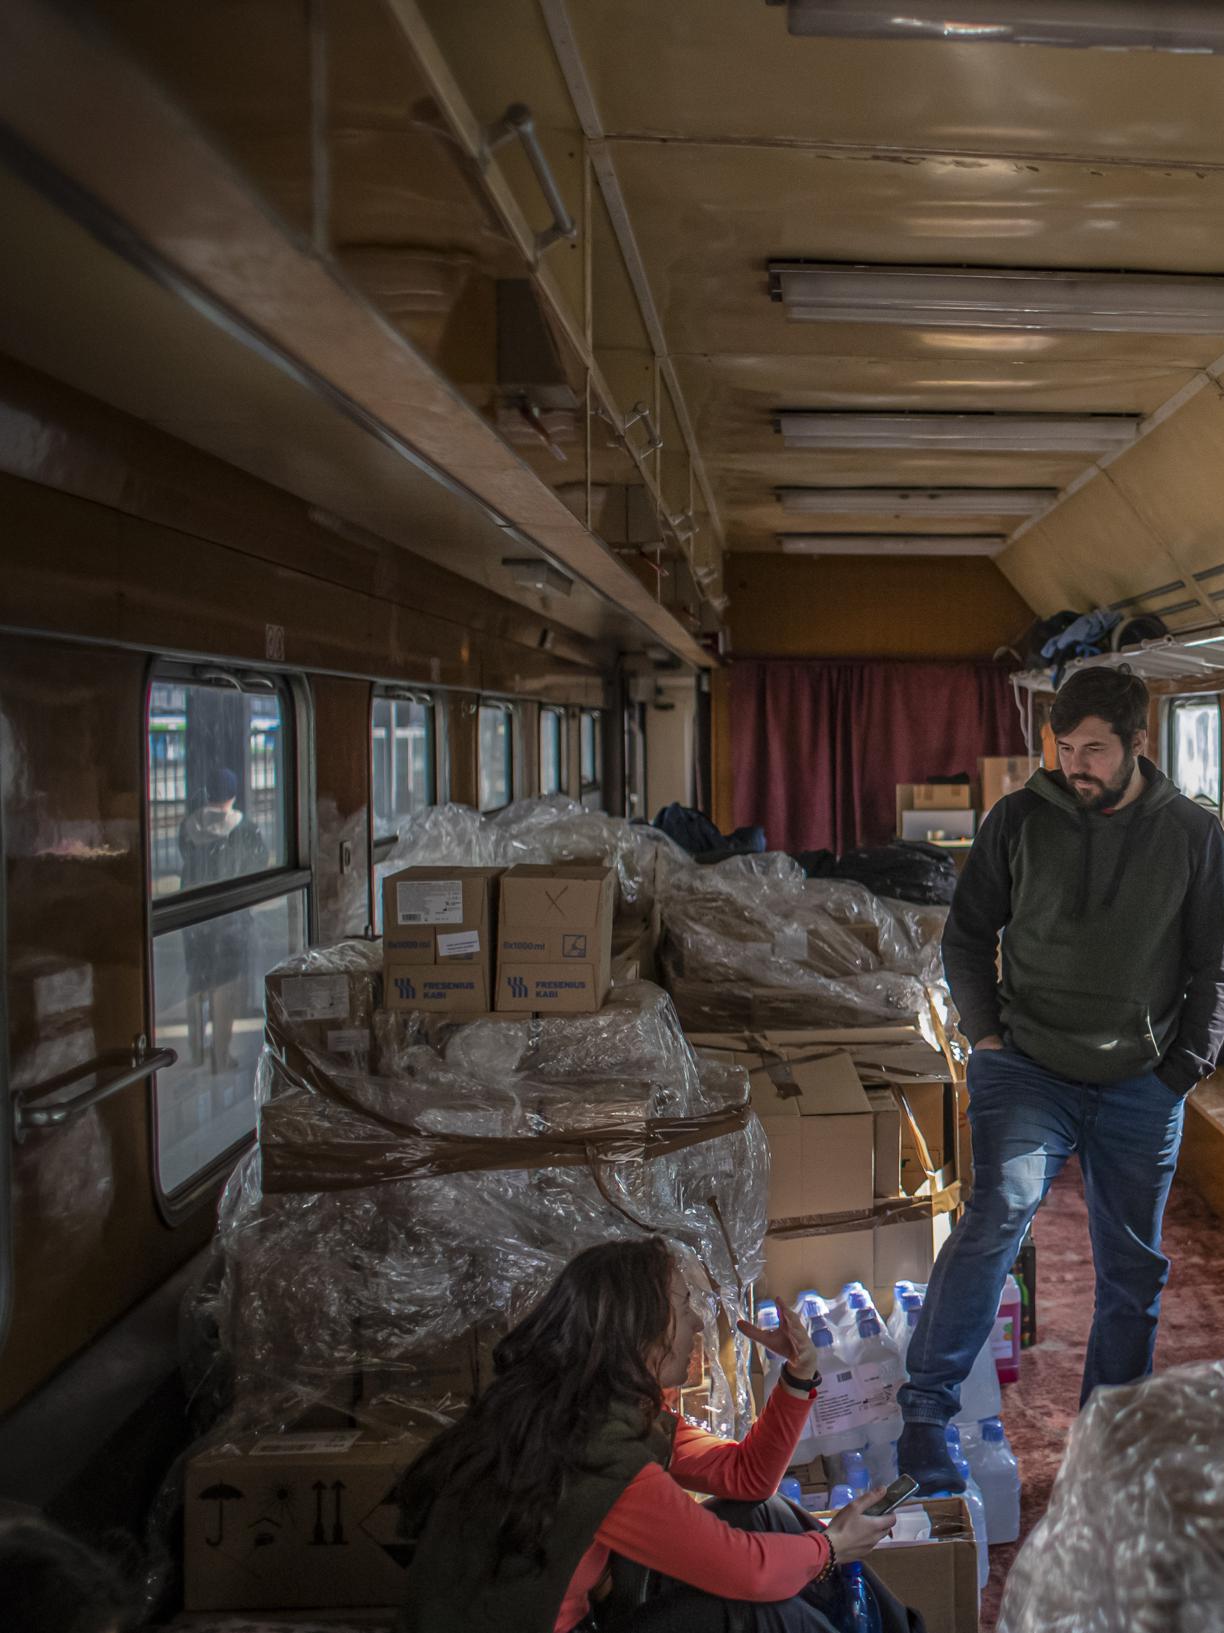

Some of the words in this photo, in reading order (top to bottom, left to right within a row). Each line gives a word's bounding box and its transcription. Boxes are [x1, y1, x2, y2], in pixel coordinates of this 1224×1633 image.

[423, 982, 475, 990] FRESENIUS
[535, 981, 586, 989] FRESENIUS
[423, 991, 447, 999] KABI
[535, 990, 559, 998] KABI
